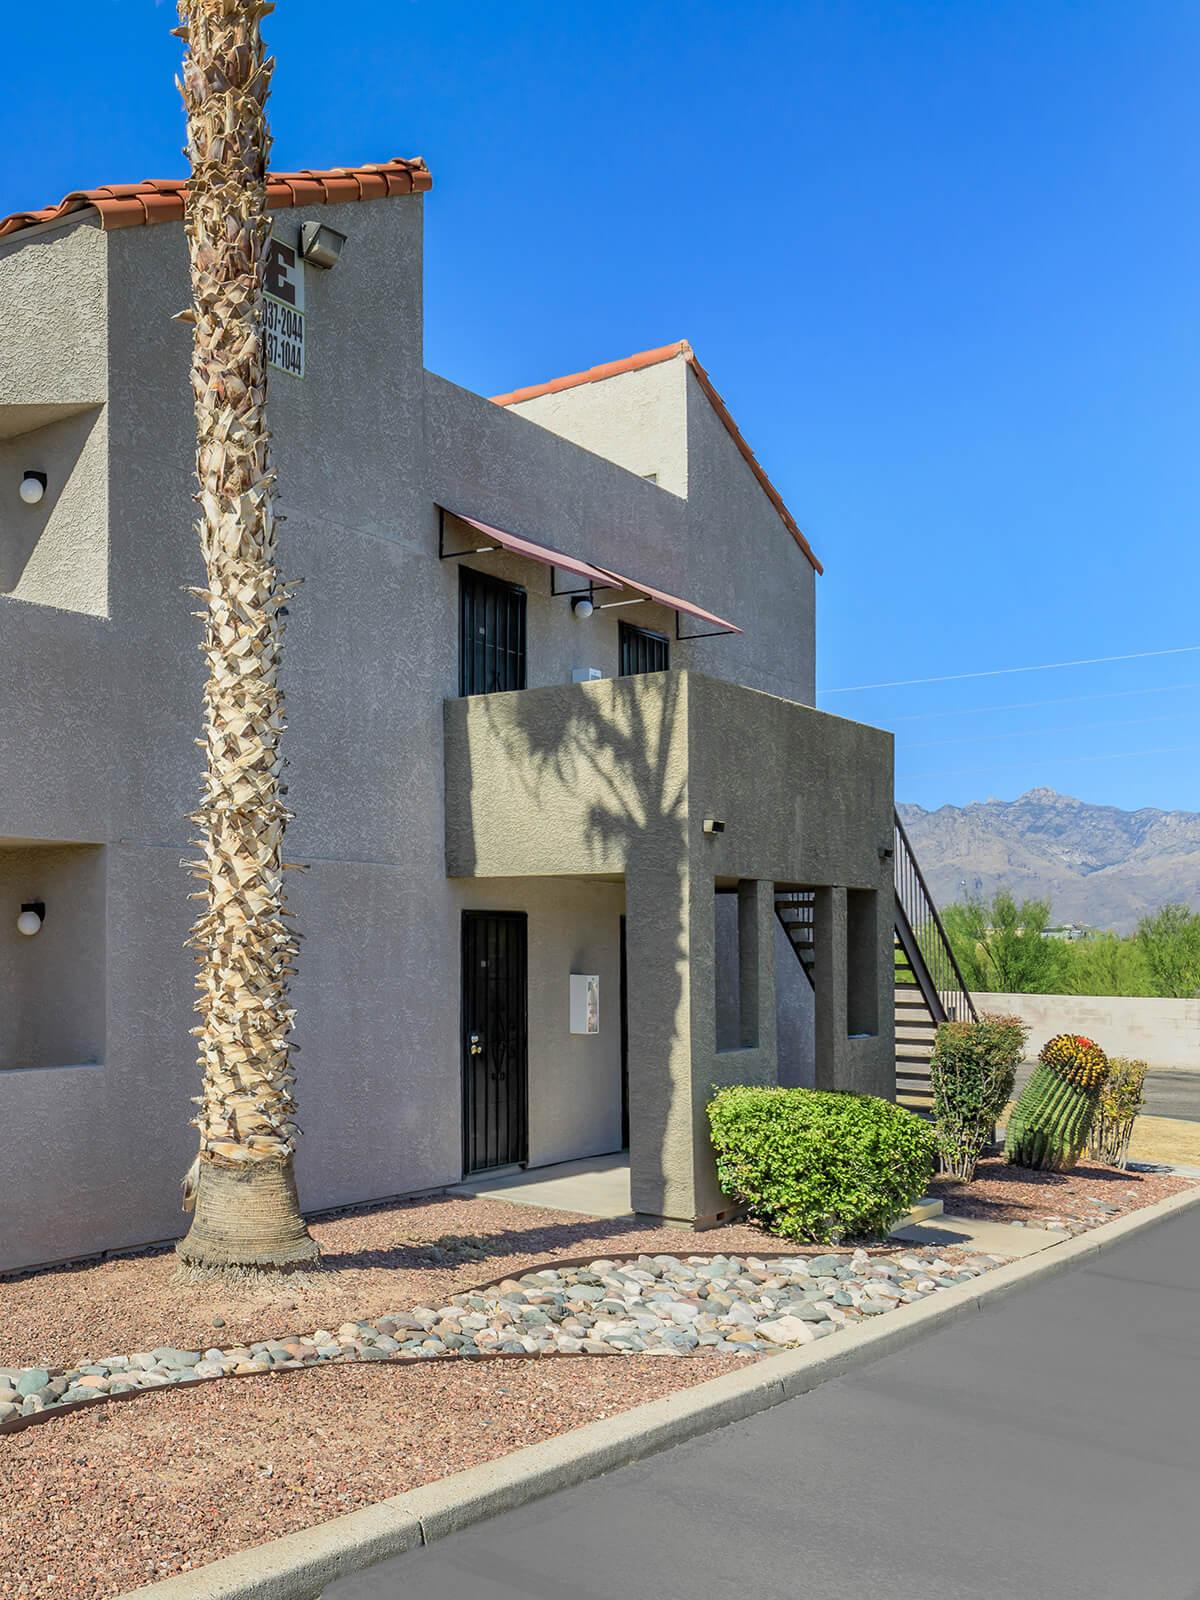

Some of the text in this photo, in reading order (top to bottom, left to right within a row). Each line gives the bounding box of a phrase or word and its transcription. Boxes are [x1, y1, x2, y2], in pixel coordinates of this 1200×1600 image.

[265, 239, 296, 305] E
[262, 297, 302, 344] 037-2044
[267, 332, 301, 375] 37-1044
